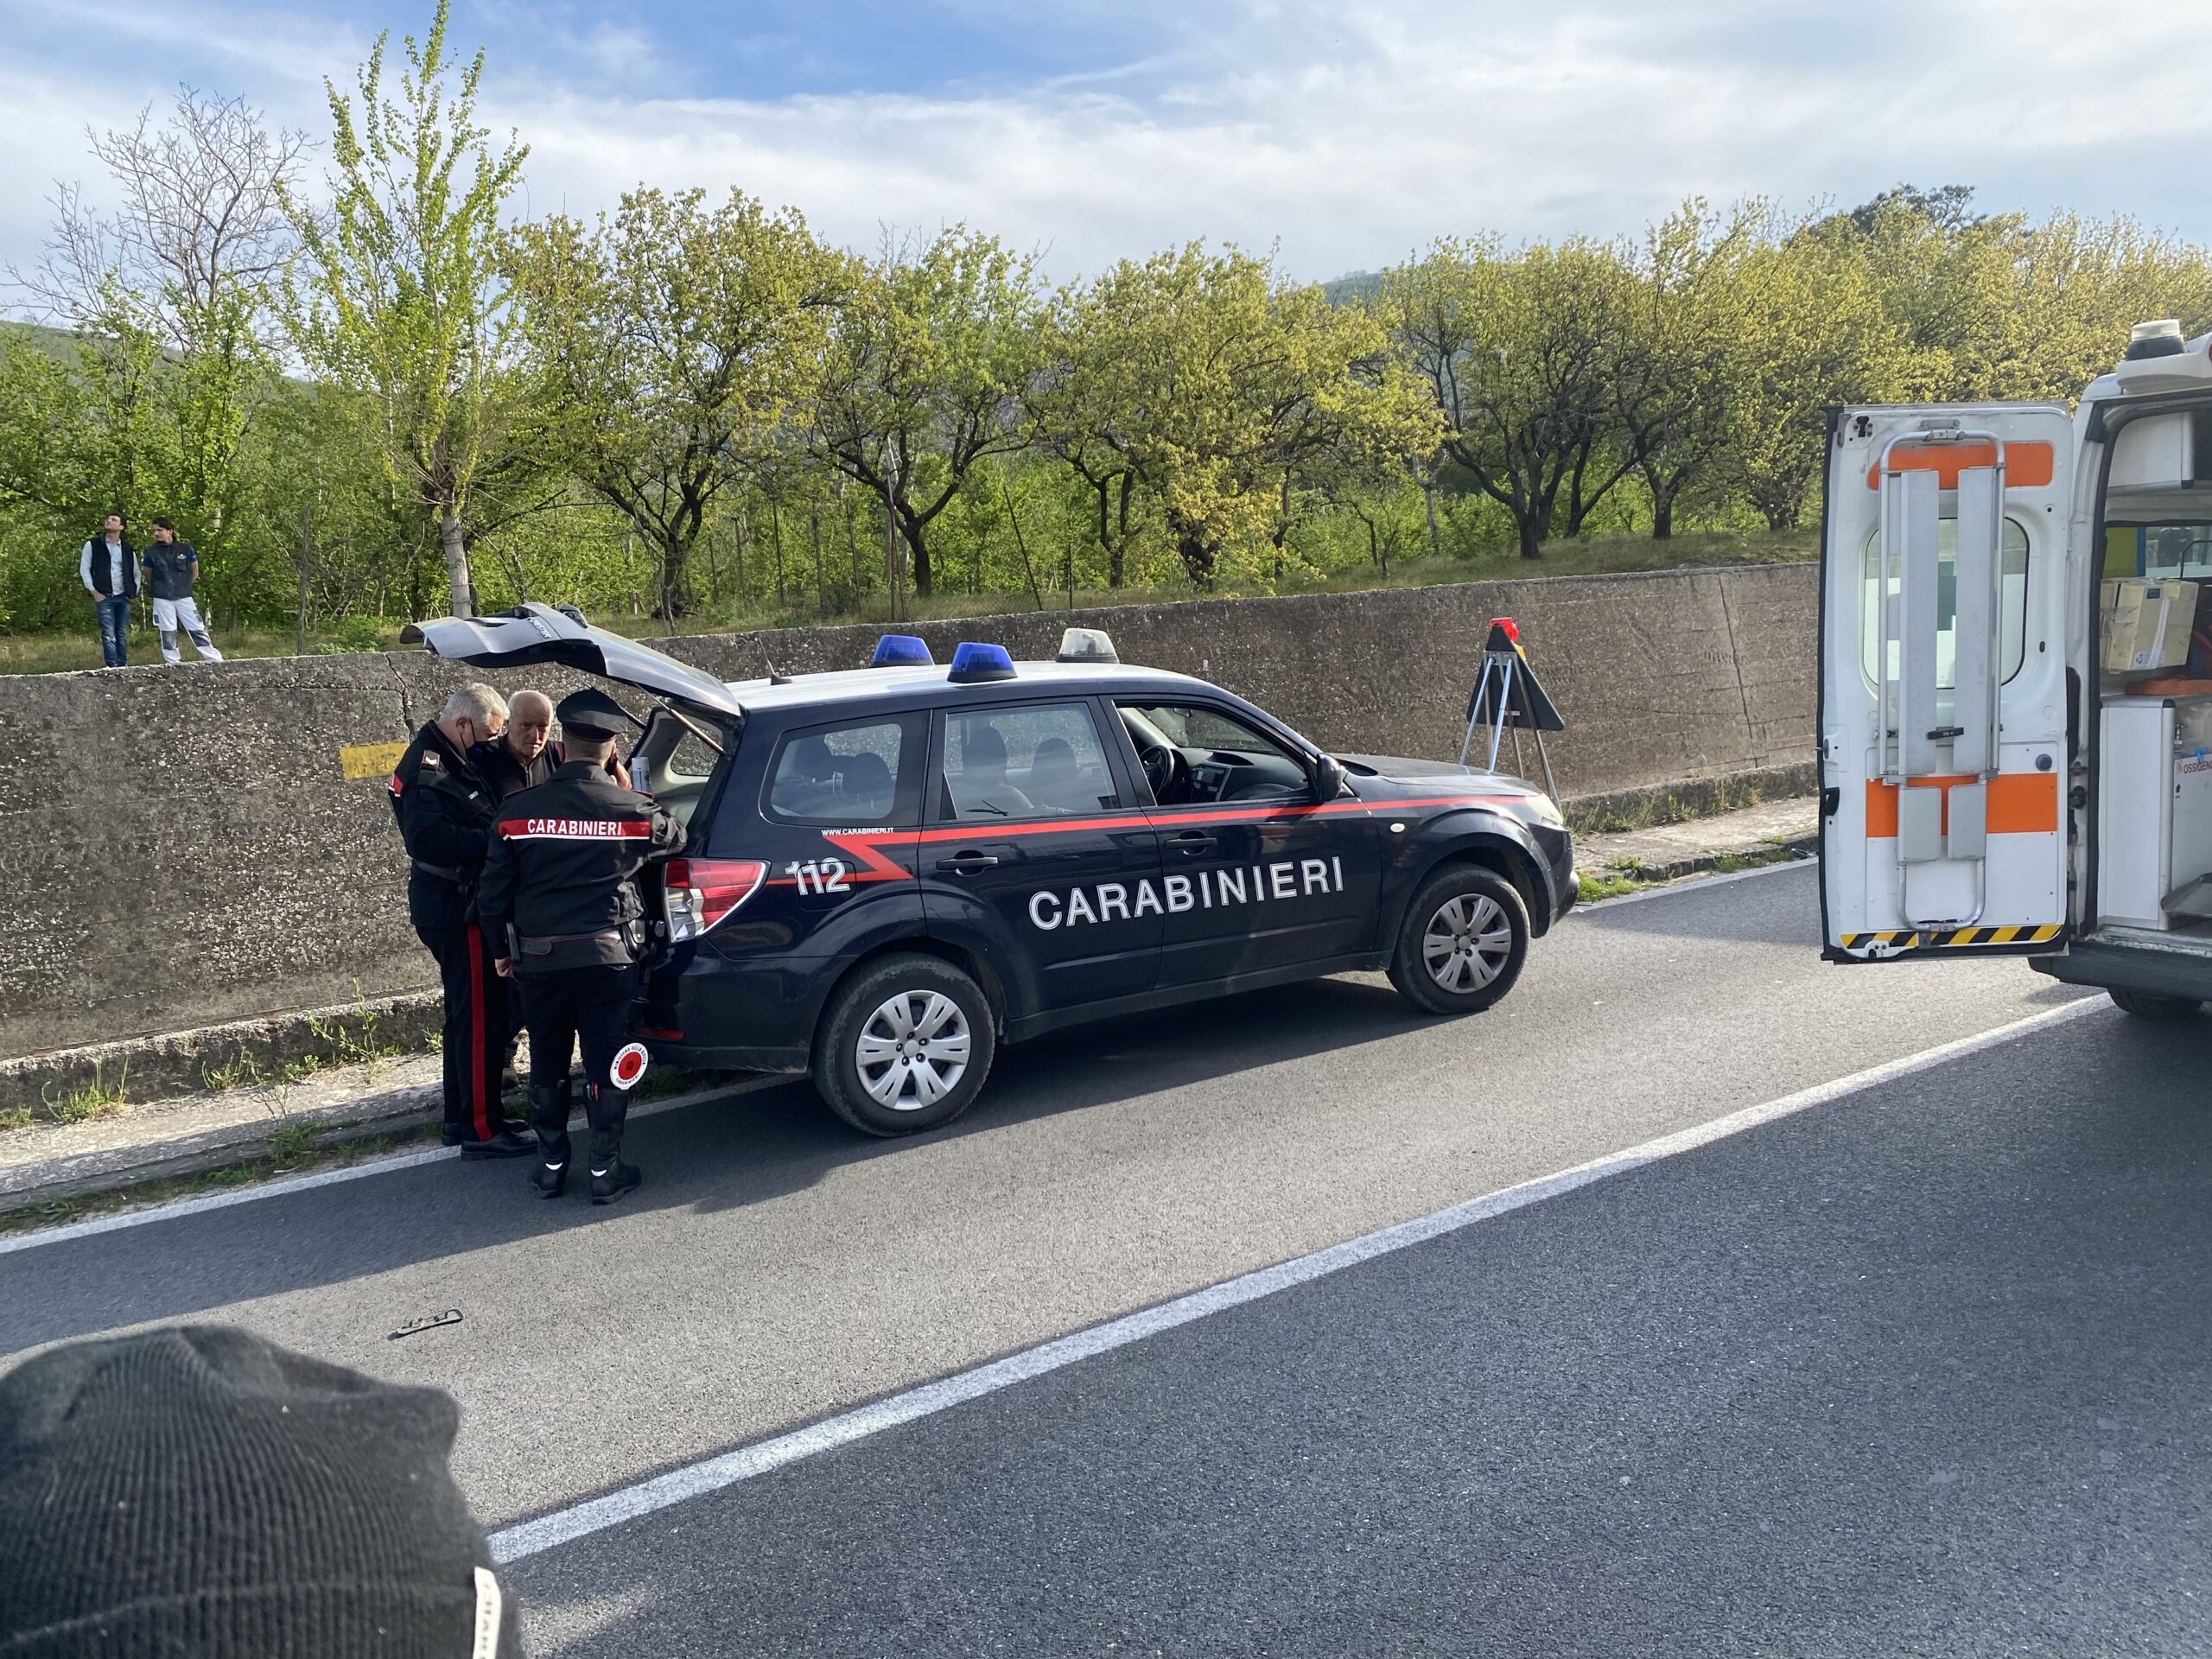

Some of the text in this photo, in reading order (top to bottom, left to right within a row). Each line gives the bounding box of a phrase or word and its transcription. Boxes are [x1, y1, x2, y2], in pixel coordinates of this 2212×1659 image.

[2183, 760, 2212, 774] OSSIGEN
[527, 818, 622, 836] CARABINIERI
[821, 827, 894, 836] WWW.CARABINIERI.IT
[785, 856, 851, 896] 112
[1028, 856, 1344, 931] CARABINIERI
